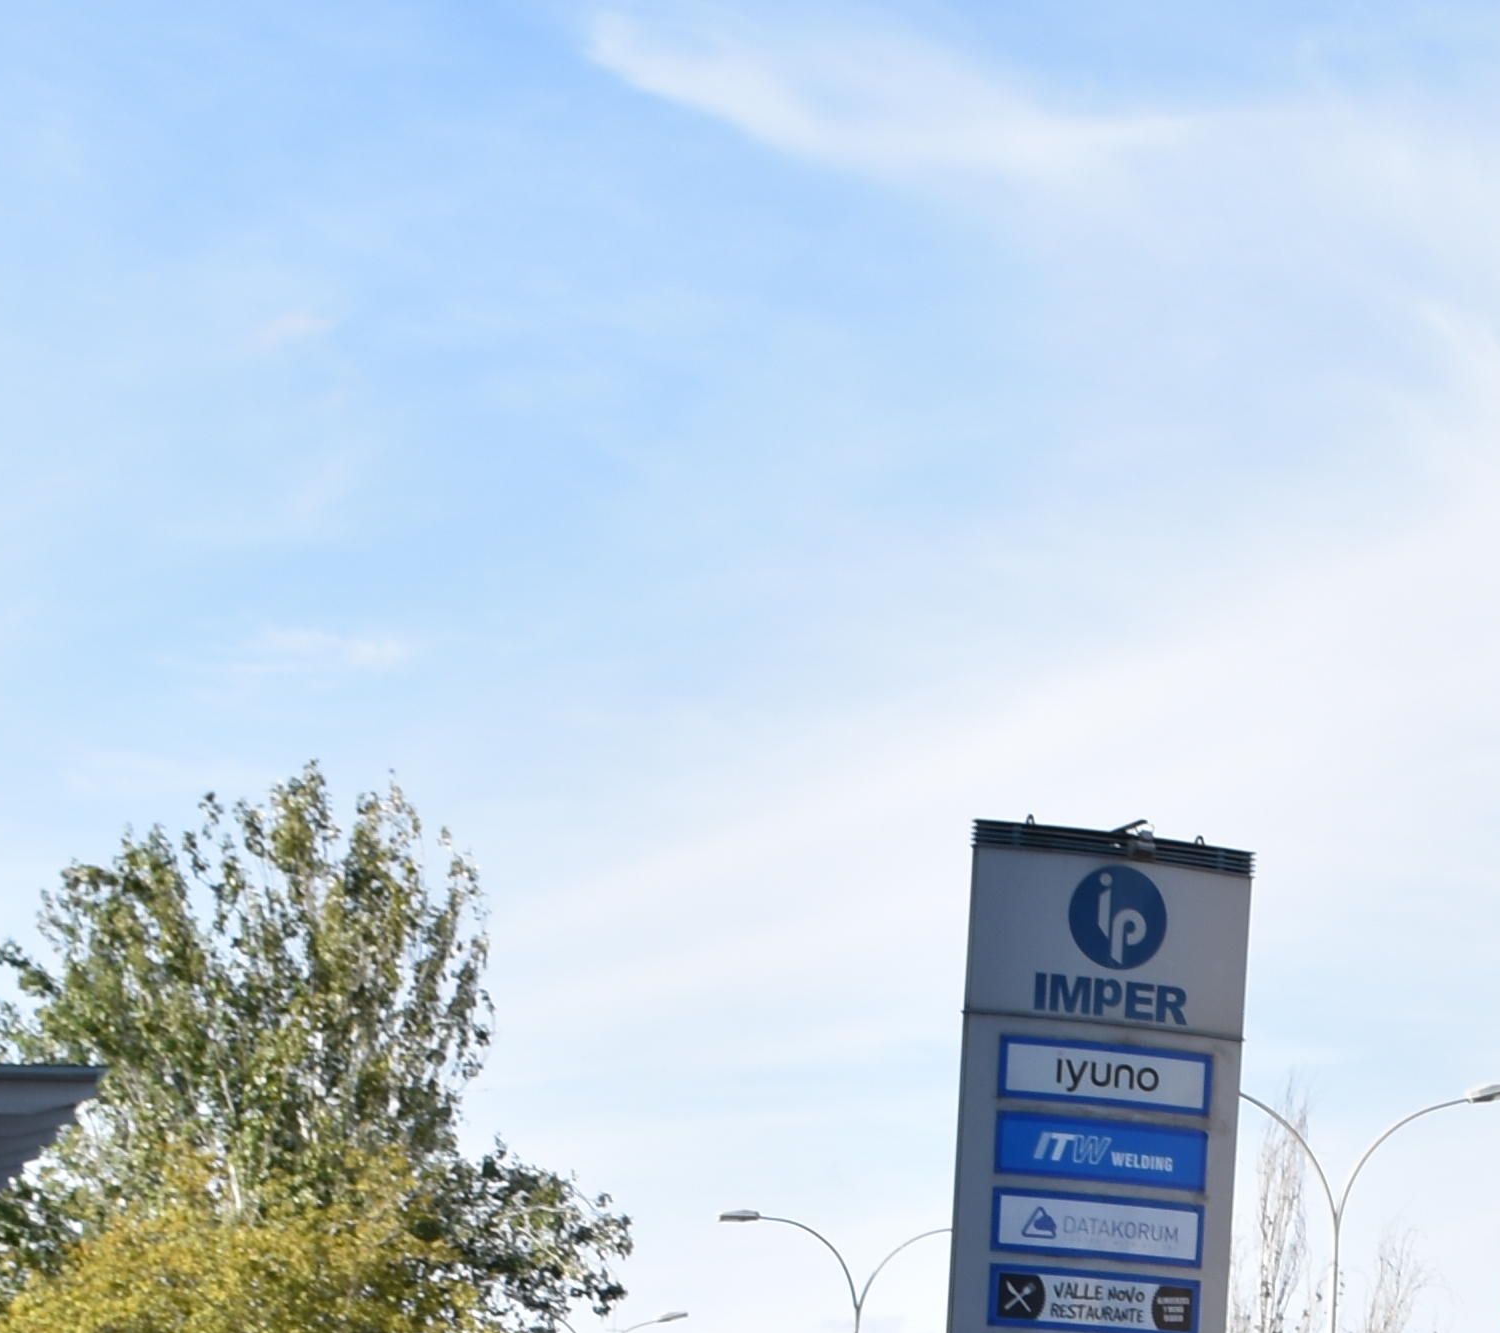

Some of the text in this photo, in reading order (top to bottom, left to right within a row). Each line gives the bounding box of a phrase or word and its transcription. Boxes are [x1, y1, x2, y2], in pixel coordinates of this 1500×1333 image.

[1033, 972, 1187, 1026] IMPER
[1055, 1049, 1159, 1092] iyuno
[1033, 1131, 1173, 1172] ITW WELDING
[1063, 1215, 1180, 1243] DATAKORUM
[1053, 1282, 1103, 1300] VALLE
[1050, 1303, 1144, 1323] RESTAURANTE
